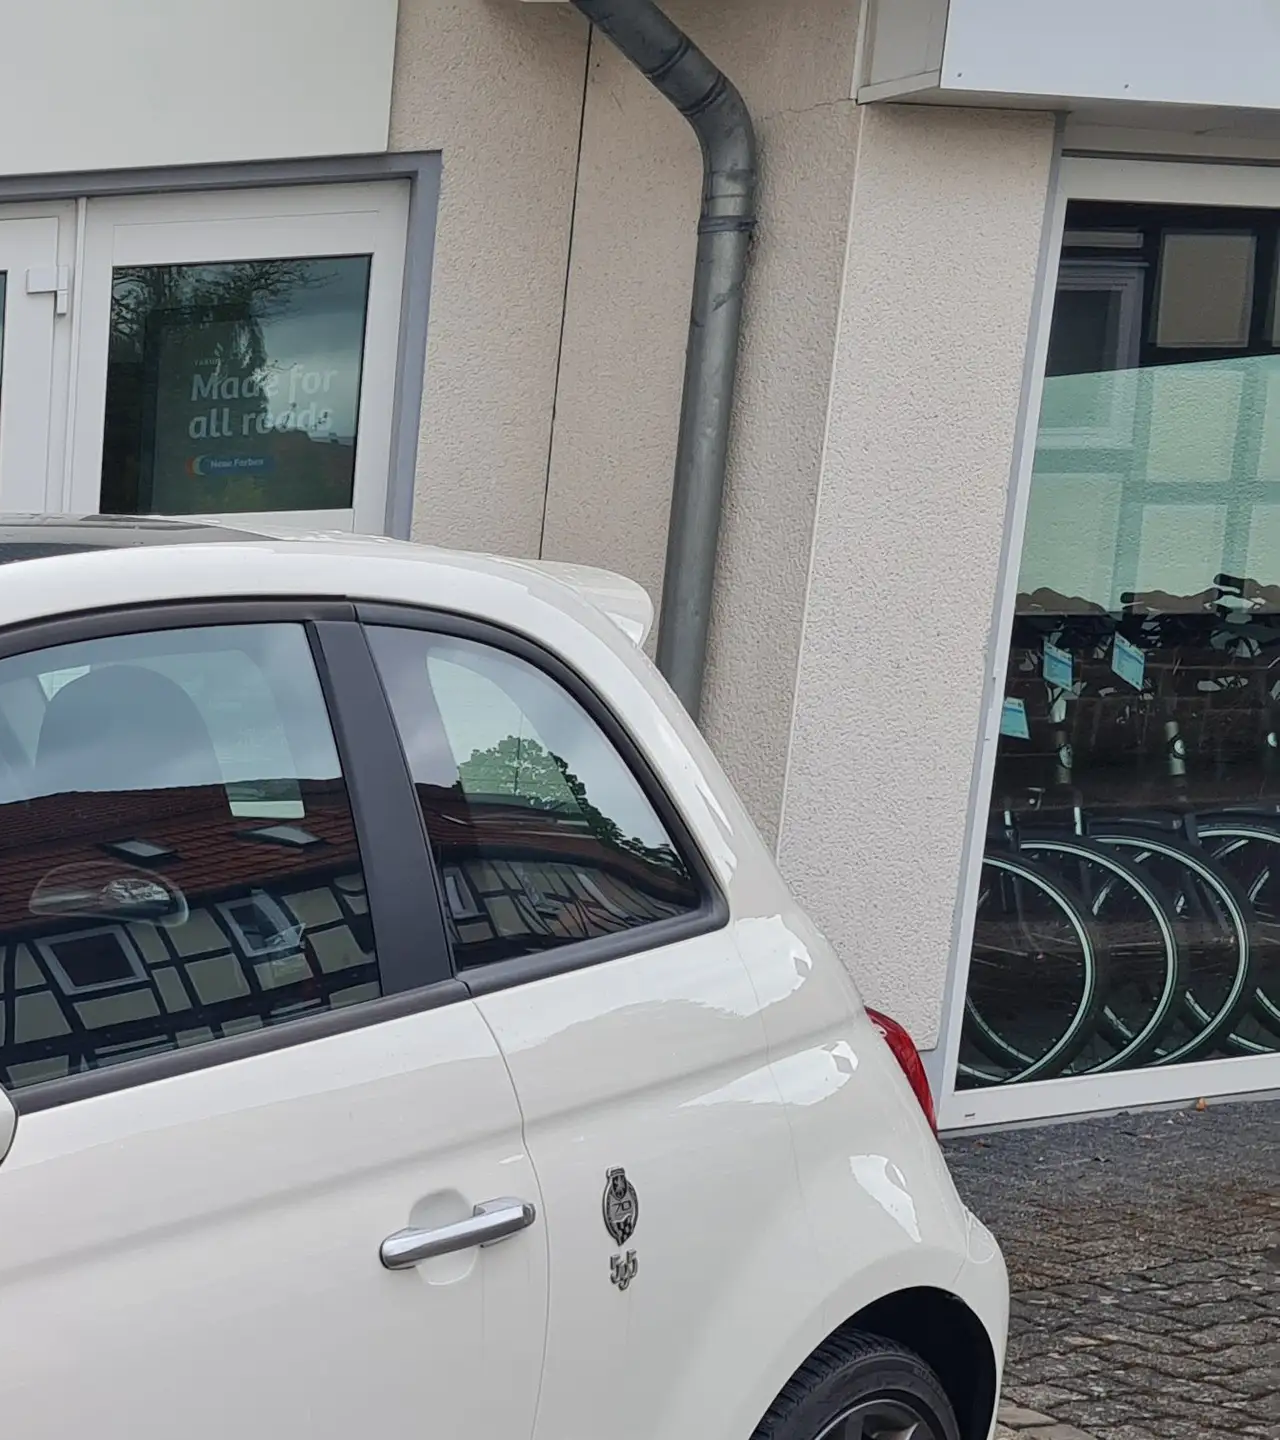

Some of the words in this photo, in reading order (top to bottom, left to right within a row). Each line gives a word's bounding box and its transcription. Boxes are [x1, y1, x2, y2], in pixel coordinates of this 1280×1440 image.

[191, 371, 279, 401] Made
[287, 363, 338, 404] for
[189, 406, 233, 440] all
[242, 402, 334, 437] roads
[612, 1200, 632, 1214] 70
